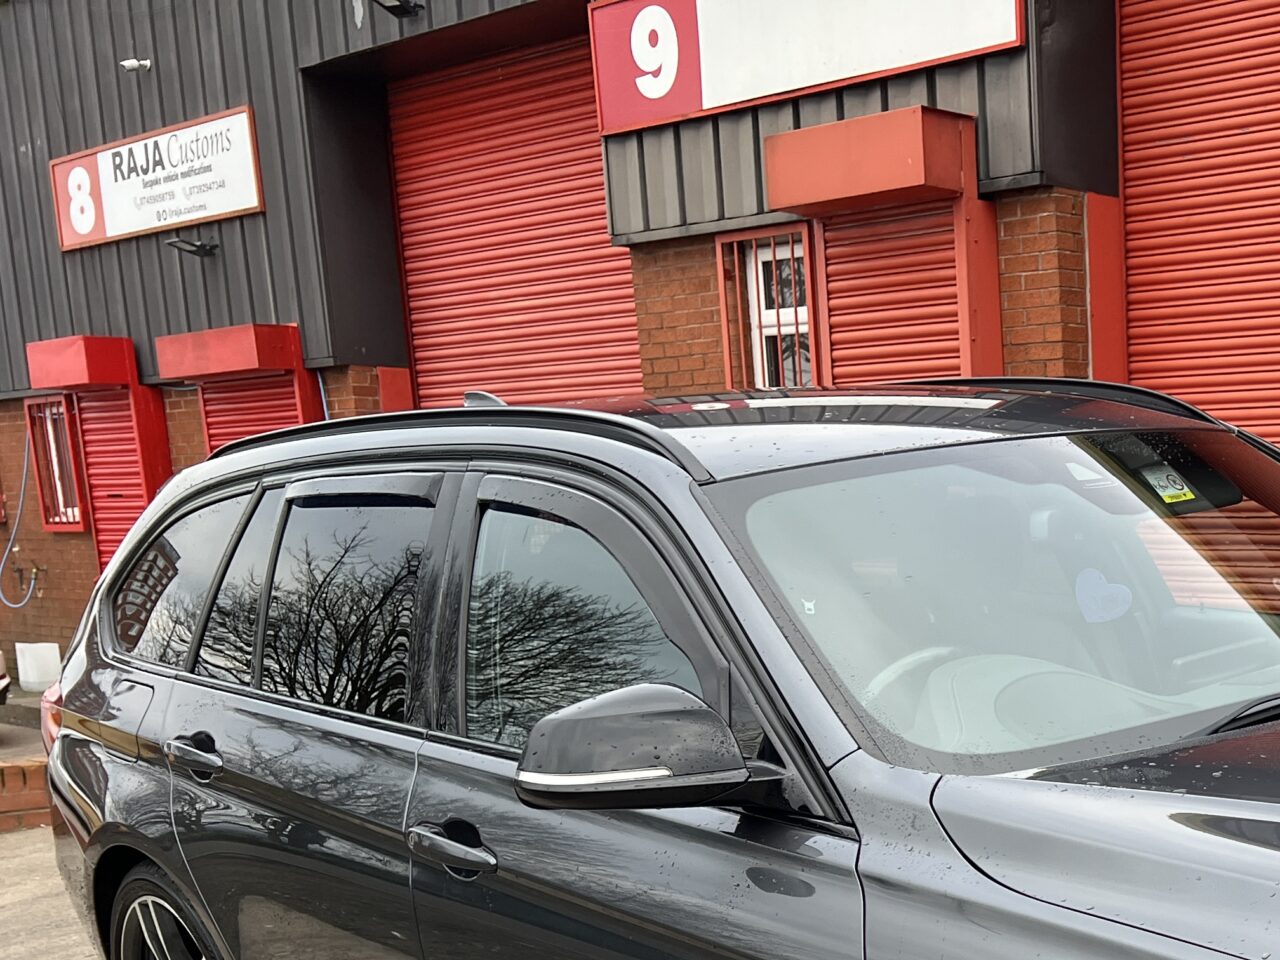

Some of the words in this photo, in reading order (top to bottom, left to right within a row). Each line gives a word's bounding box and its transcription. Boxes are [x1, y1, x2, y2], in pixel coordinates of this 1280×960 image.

[631, 5, 678, 99] 9
[111, 140, 165, 183] RAJA
[167, 128, 232, 168] Customs
[163, 170, 179, 184] vehicle
[180, 162, 212, 179] modifications
[68, 167, 95, 234] 8
